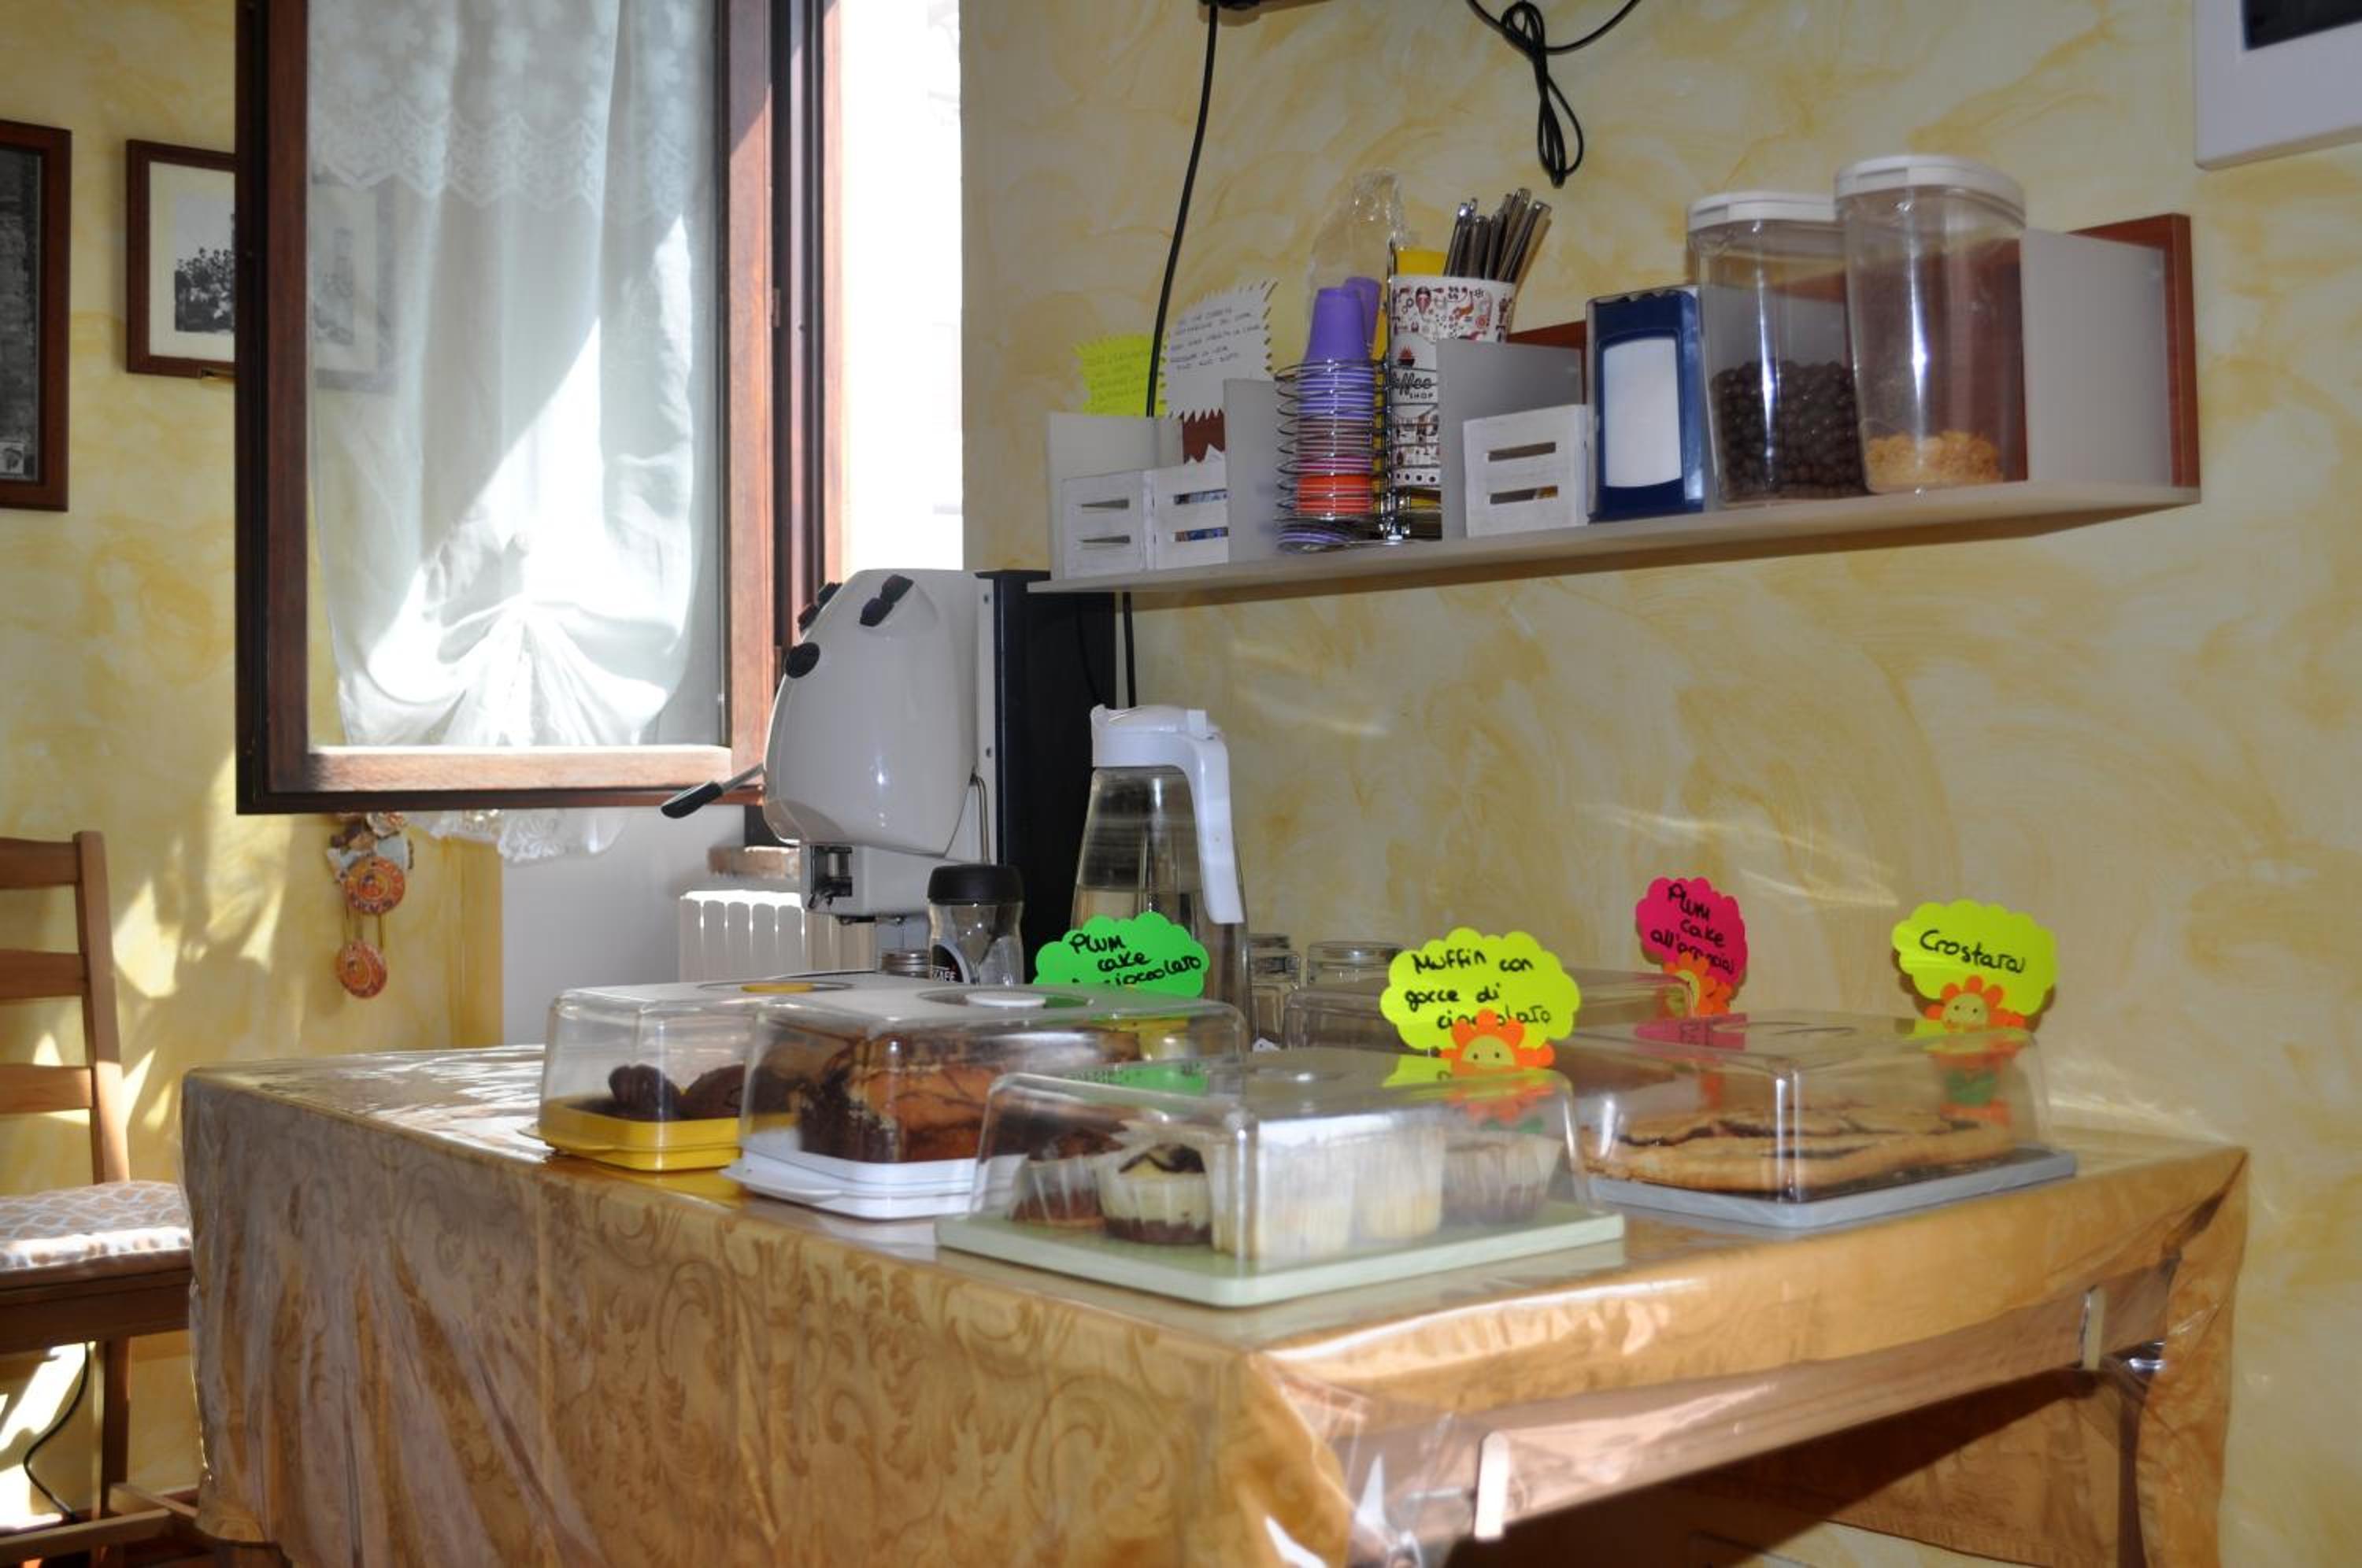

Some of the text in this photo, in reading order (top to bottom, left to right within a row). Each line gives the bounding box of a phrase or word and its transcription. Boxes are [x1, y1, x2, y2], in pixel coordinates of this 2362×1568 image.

[1104, 955, 1201, 986] ioccolato
[1412, 948, 1534, 974] Muffin con
[1405, 982, 1501, 1013] gocce di
